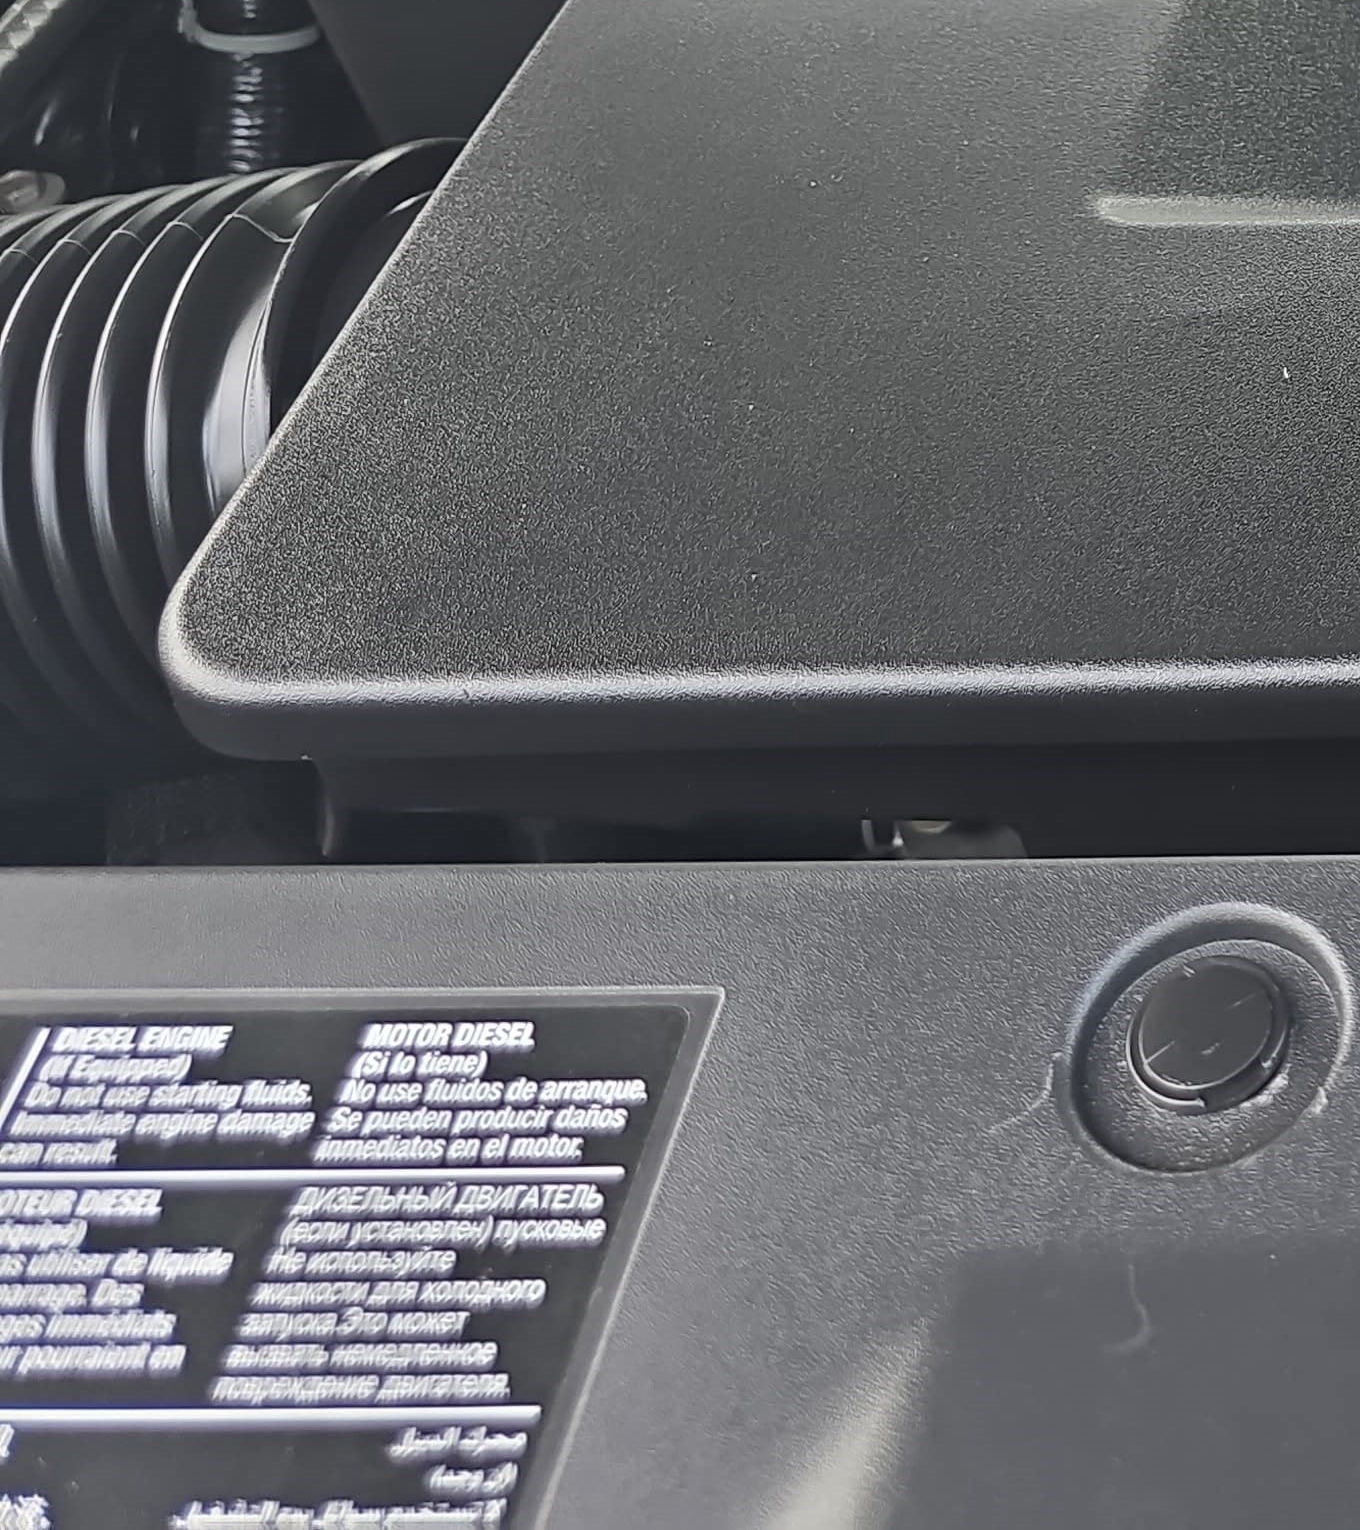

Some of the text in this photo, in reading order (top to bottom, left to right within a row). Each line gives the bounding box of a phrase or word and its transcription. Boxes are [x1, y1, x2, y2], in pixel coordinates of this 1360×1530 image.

[50, 1025, 234, 1053] DIESEL ENGINE
[362, 1022, 535, 1049] MOTOR DIESEL
[40, 1054, 192, 1082] (If Equipped)
[353, 1051, 487, 1077] (Si lo tiene)
[24, 1080, 312, 1110] Do not use starting fluids.
[340, 1077, 648, 1104] No use fluidos de arranque.
[10, 1109, 316, 1138] Immediate engine damage
[327, 1104, 629, 1136] Se pueden producir daños
[43, 1139, 117, 1165] result.
[313, 1134, 583, 1162] inmediatos en el motor.
[0, 1188, 163, 1217] OTEUR DIESEL
[290, 1181, 604, 1216] ДИЗЕЛЬНЫЙ ДВИГАТЕЛЬ
[280, 1216, 606, 1249] (если установлен) пусковые
[112, 1248, 148, 1276] de
[147, 1247, 234, 1281] liquide
[267, 1247, 457, 1277] Не используйте
[90, 1279, 145, 1307] Des
[251, 1279, 547, 1307] жидкости для холодного
[386, 1311, 471, 1336] может
[328, 1342, 498, 1369] немедленное
[211, 1374, 380, 1405] повреждение
